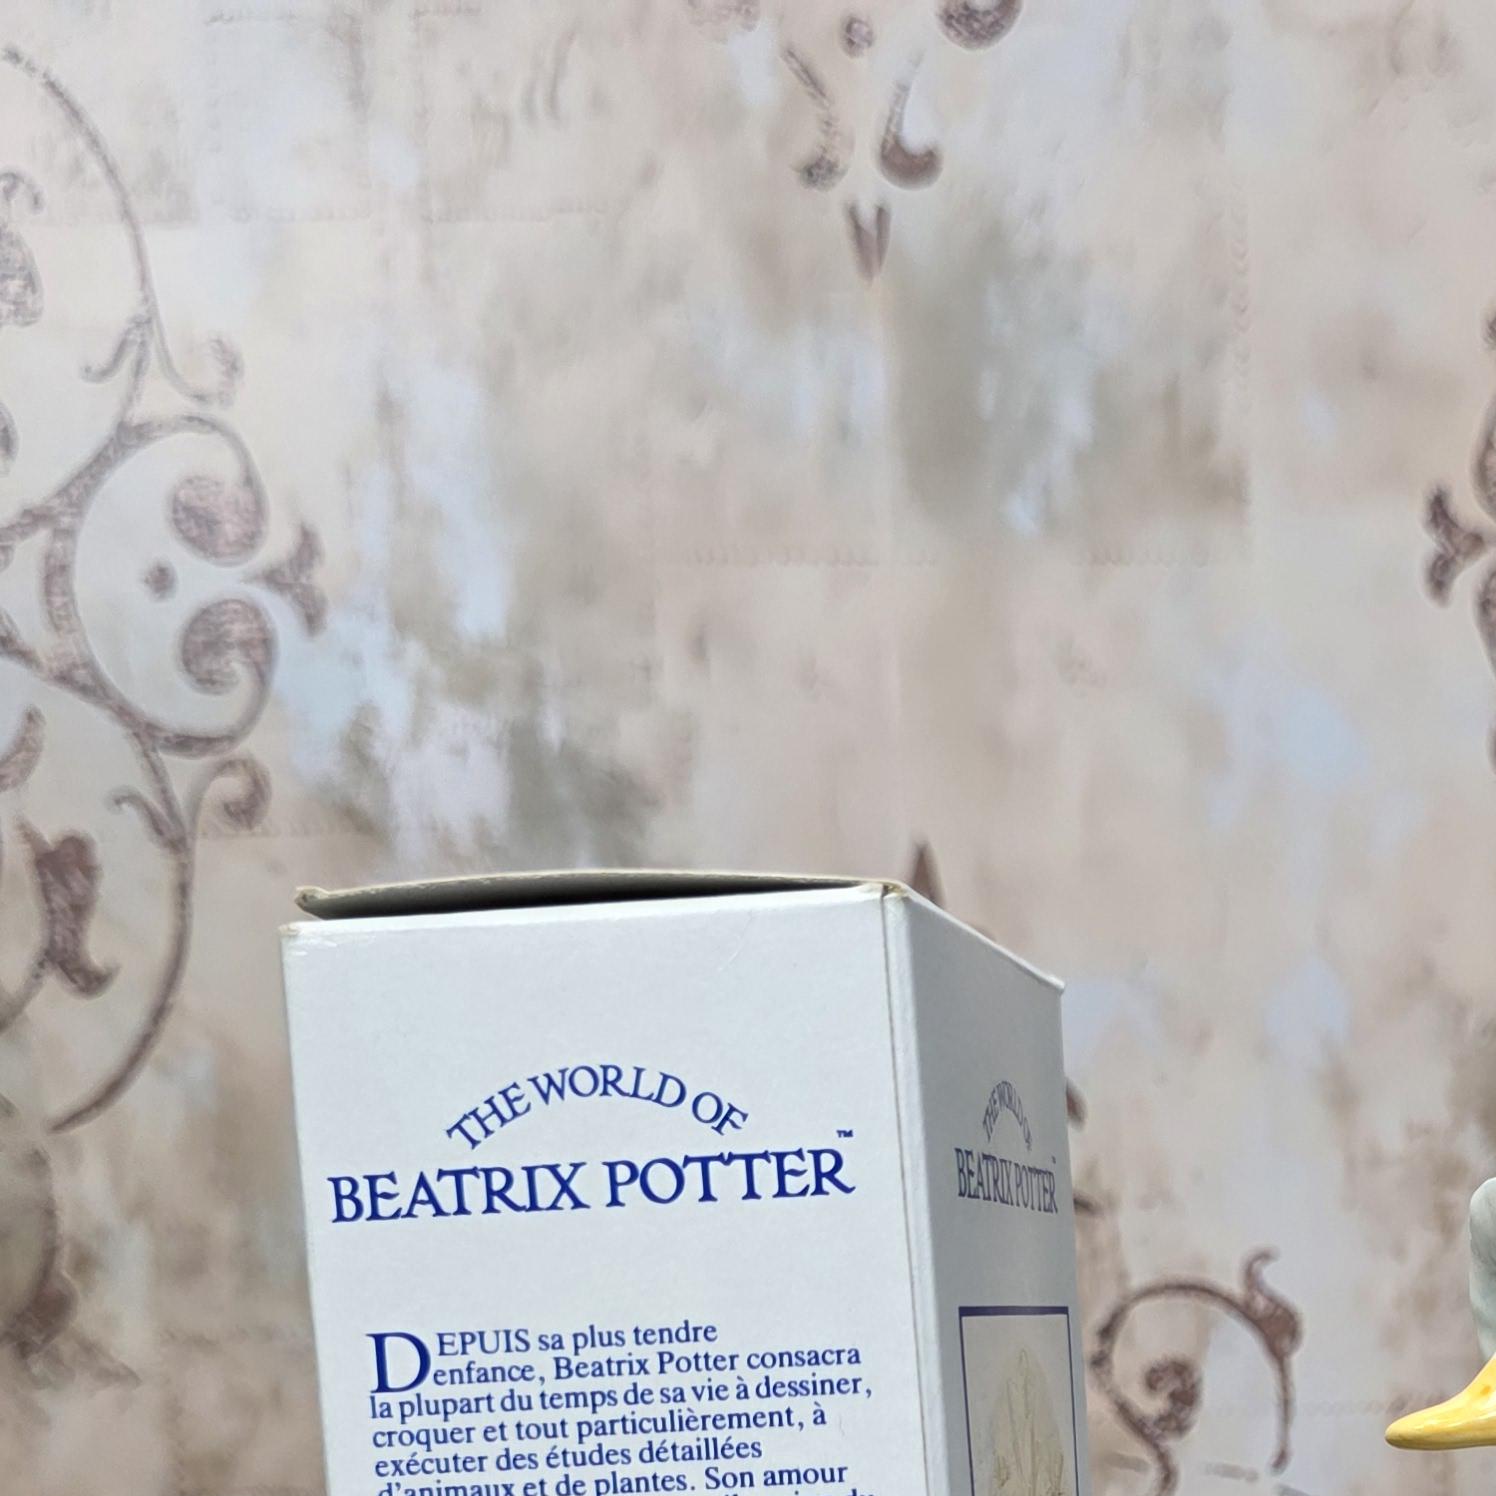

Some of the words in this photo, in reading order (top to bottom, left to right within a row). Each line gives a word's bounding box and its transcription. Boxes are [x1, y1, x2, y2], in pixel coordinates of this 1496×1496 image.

[446, 1081, 532, 1150] THE
[527, 1063, 687, 1108] WORLD
[691, 1091, 749, 1136] OF
[327, 1161, 591, 1223] BEATRIX
[602, 1147, 856, 1208] POTTER
[954, 1147, 1014, 1207] BEATRIX
[1014, 1162, 1058, 1214] POTTER
[537, 1333, 566, 1352] sa
[571, 1323, 626, 1357] plus
[632, 1319, 718, 1347] tendre
[432, 1359, 546, 1387] enfance,
[552, 1351, 651, 1381] Beatrix
[656, 1350, 740, 1375] Potter
[746, 1347, 862, 1370] consacra
[369, 1394, 394, 1420] la
[398, 1392, 496, 1426] plupart
[499, 1387, 534, 1413] du
[538, 1389, 619, 1415] temps
[622, 1381, 655, 1406] de
[659, 1386, 687, 1404] sa
[690, 1377, 730, 1402] vie
[735, 1375, 751, 1401] à
[755, 1371, 872, 1400] dessiner,
[372, 1426, 477, 1453] croquer
[482, 1421, 508, 1443] et
[514, 1418, 569, 1441] tout
[576, 1406, 805, 1445] particulièrement,
[812, 1400, 828, 1426] à
[374, 1451, 489, 1478] exécuter
[495, 1447, 539, 1472] des
[545, 1442, 632, 1469] études
[638, 1435, 763, 1464] détaillées
[704, 1466, 755, 1490] Son
[763, 1466, 849, 1487] amour
